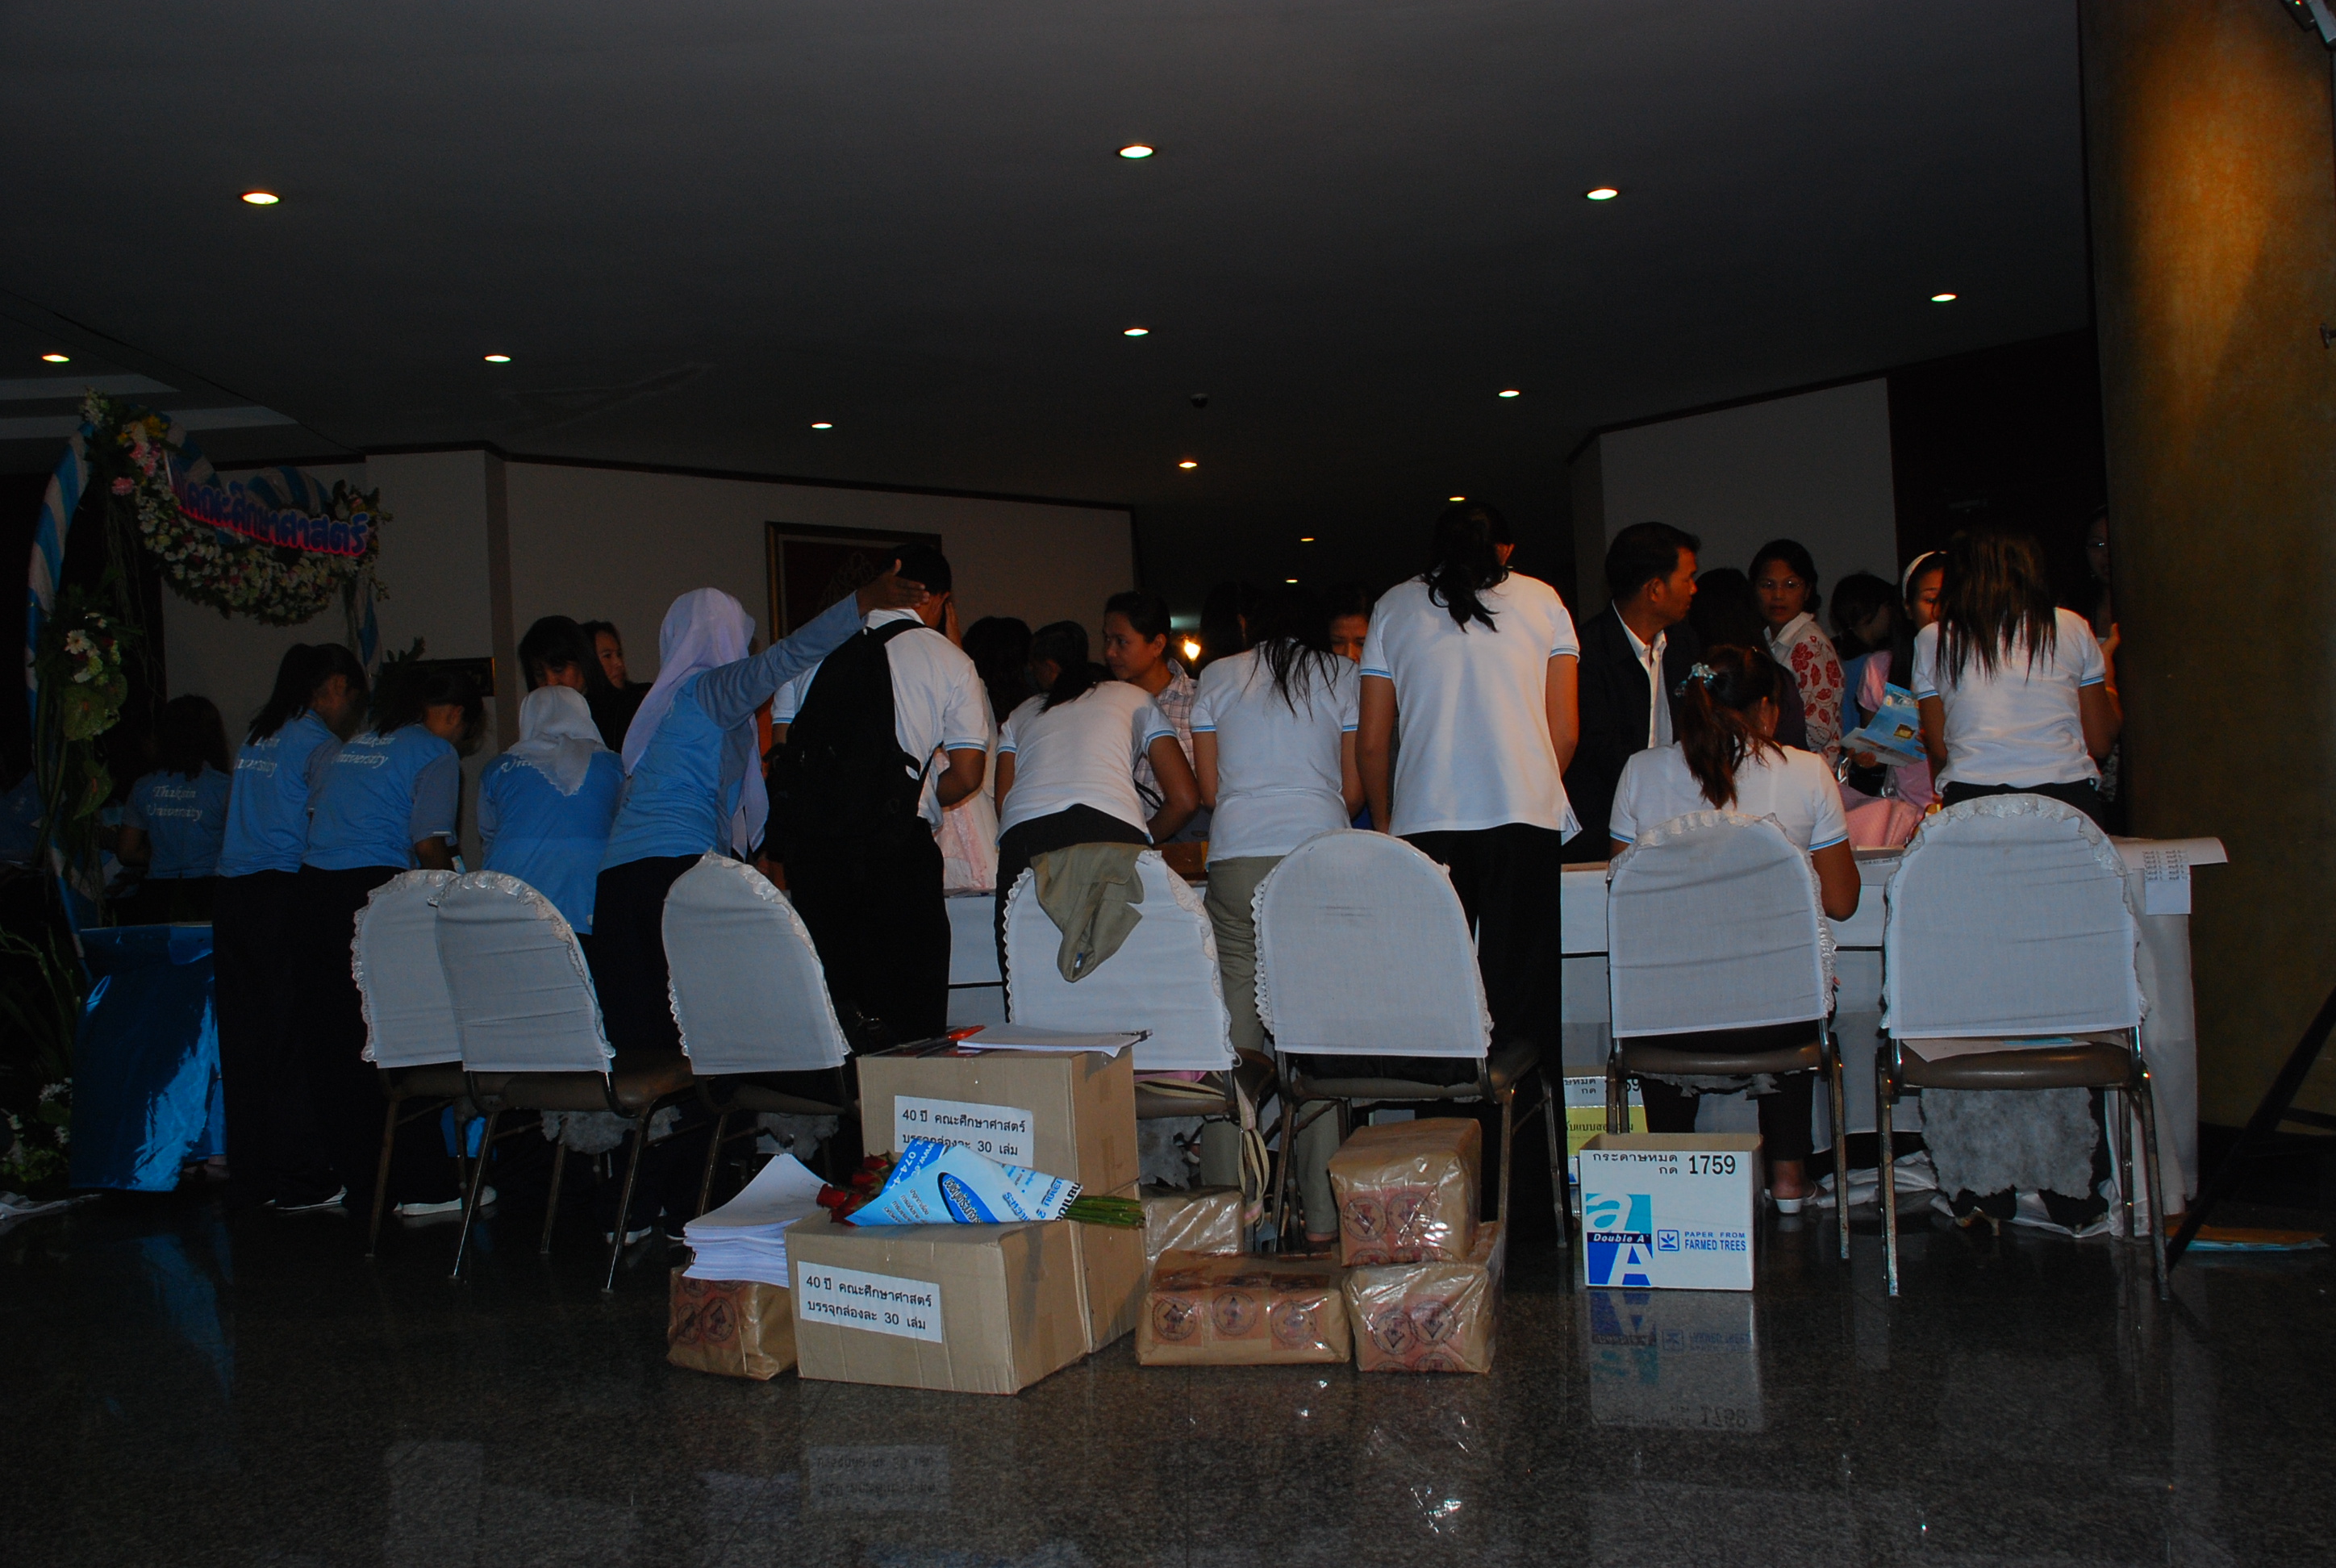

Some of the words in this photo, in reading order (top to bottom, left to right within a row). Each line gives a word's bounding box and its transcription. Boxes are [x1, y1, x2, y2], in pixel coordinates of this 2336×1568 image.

[152, 785, 196, 801] Thaksin
[147, 803, 203, 822] University
[902, 1109, 917, 1121] 40
[920, 1110, 928, 1123] ปี
[934, 1113, 1027, 1133] คณะศึกษาศาสตร์
[977, 1140, 993, 1153] 30
[999, 1143, 1019, 1156] เล่ม
[1592, 1153, 1679, 1162] กระดาษหมด
[1688, 1155, 1736, 1175] 1759
[1658, 1166, 1679, 1174] กด
[1593, 1233, 1633, 1243] Double
[1636, 1234, 1645, 1243] A
[1684, 1239, 1717, 1250] FARMED
[1719, 1240, 1746, 1251] TREES
[806, 1275, 821, 1289] 40
[824, 1277, 832, 1291] ปี
[838, 1282, 932, 1307] คณะศึกษาศาสตร์
[807, 1299, 878, 1321] บรรจุกล่องละ
[884, 1312, 899, 1325] 30
[906, 1317, 926, 1330] เล่ม
